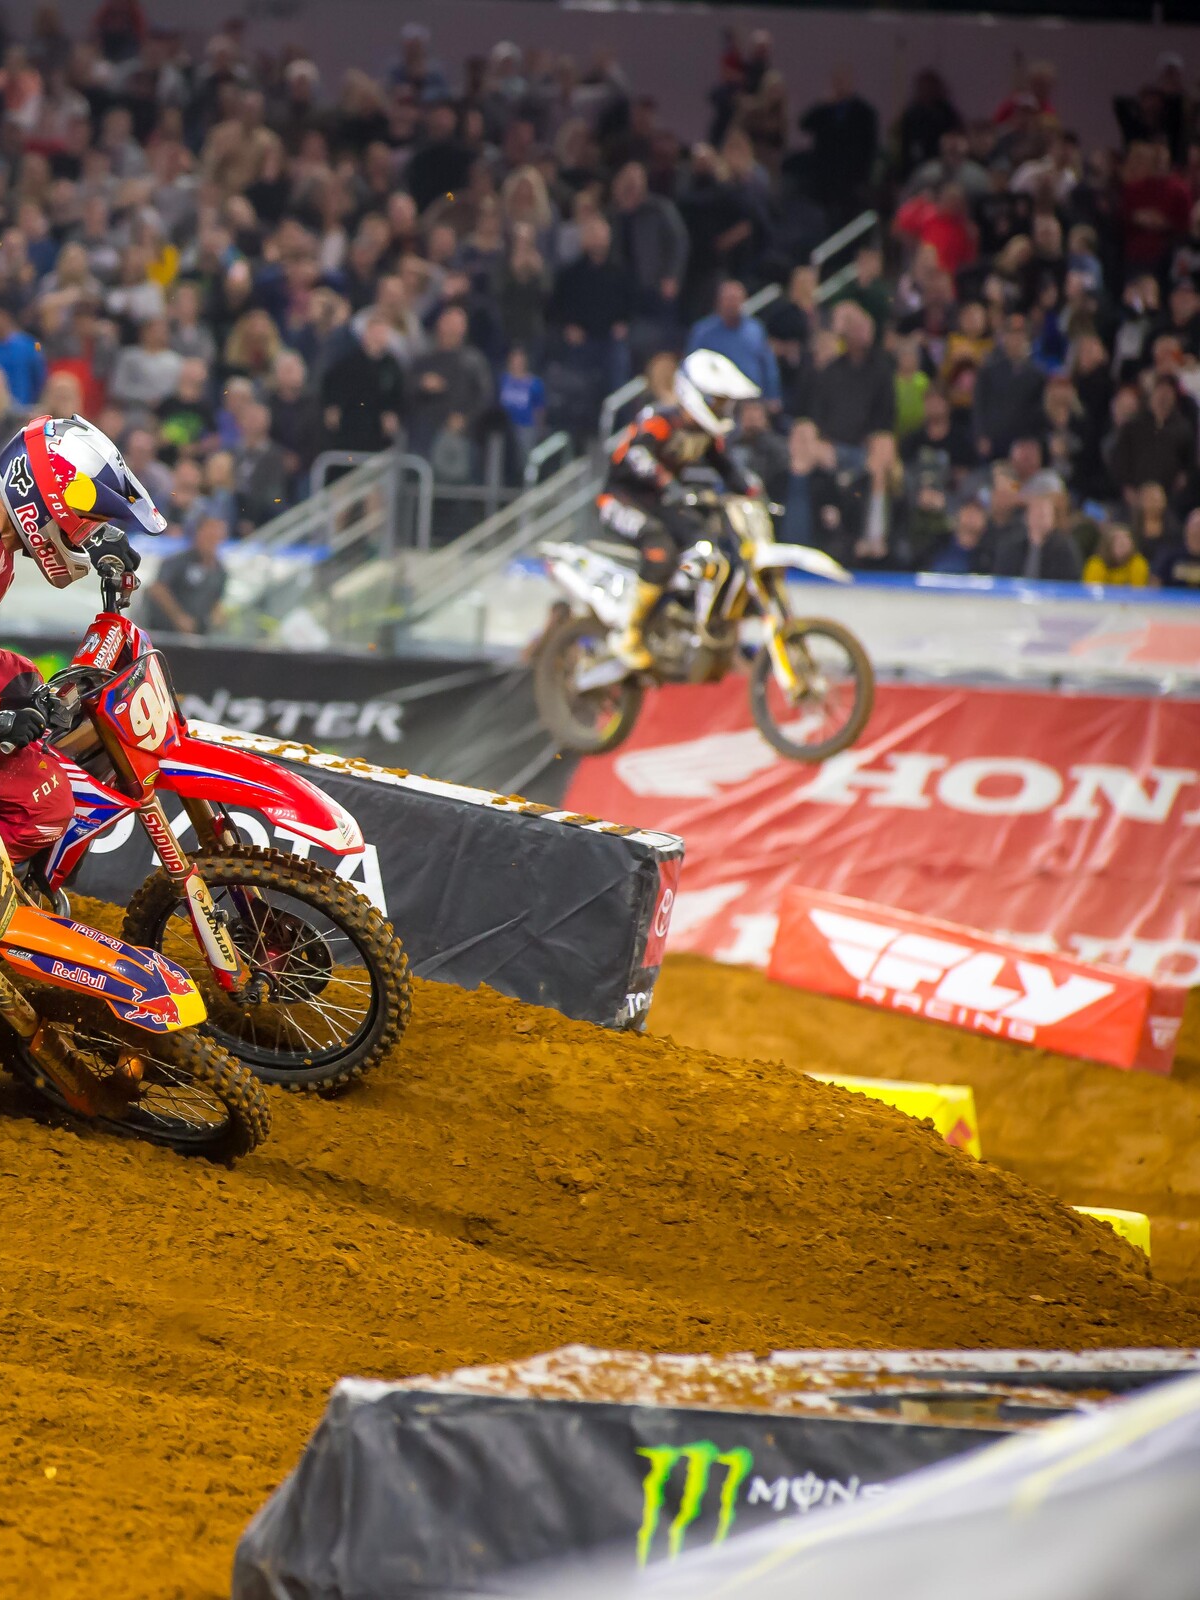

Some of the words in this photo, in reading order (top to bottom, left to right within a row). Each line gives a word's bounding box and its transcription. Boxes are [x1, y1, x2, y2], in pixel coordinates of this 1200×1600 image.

[47, 492, 69, 519] FOX
[93, 624, 122, 668] RENTHAL
[31, 774, 61, 803] FOX
[806, 751, 1200, 824] HON
[140, 811, 185, 874] SHOWA
[201, 906, 235, 965] DUNLOP
[807, 908, 1117, 1026] FLY
